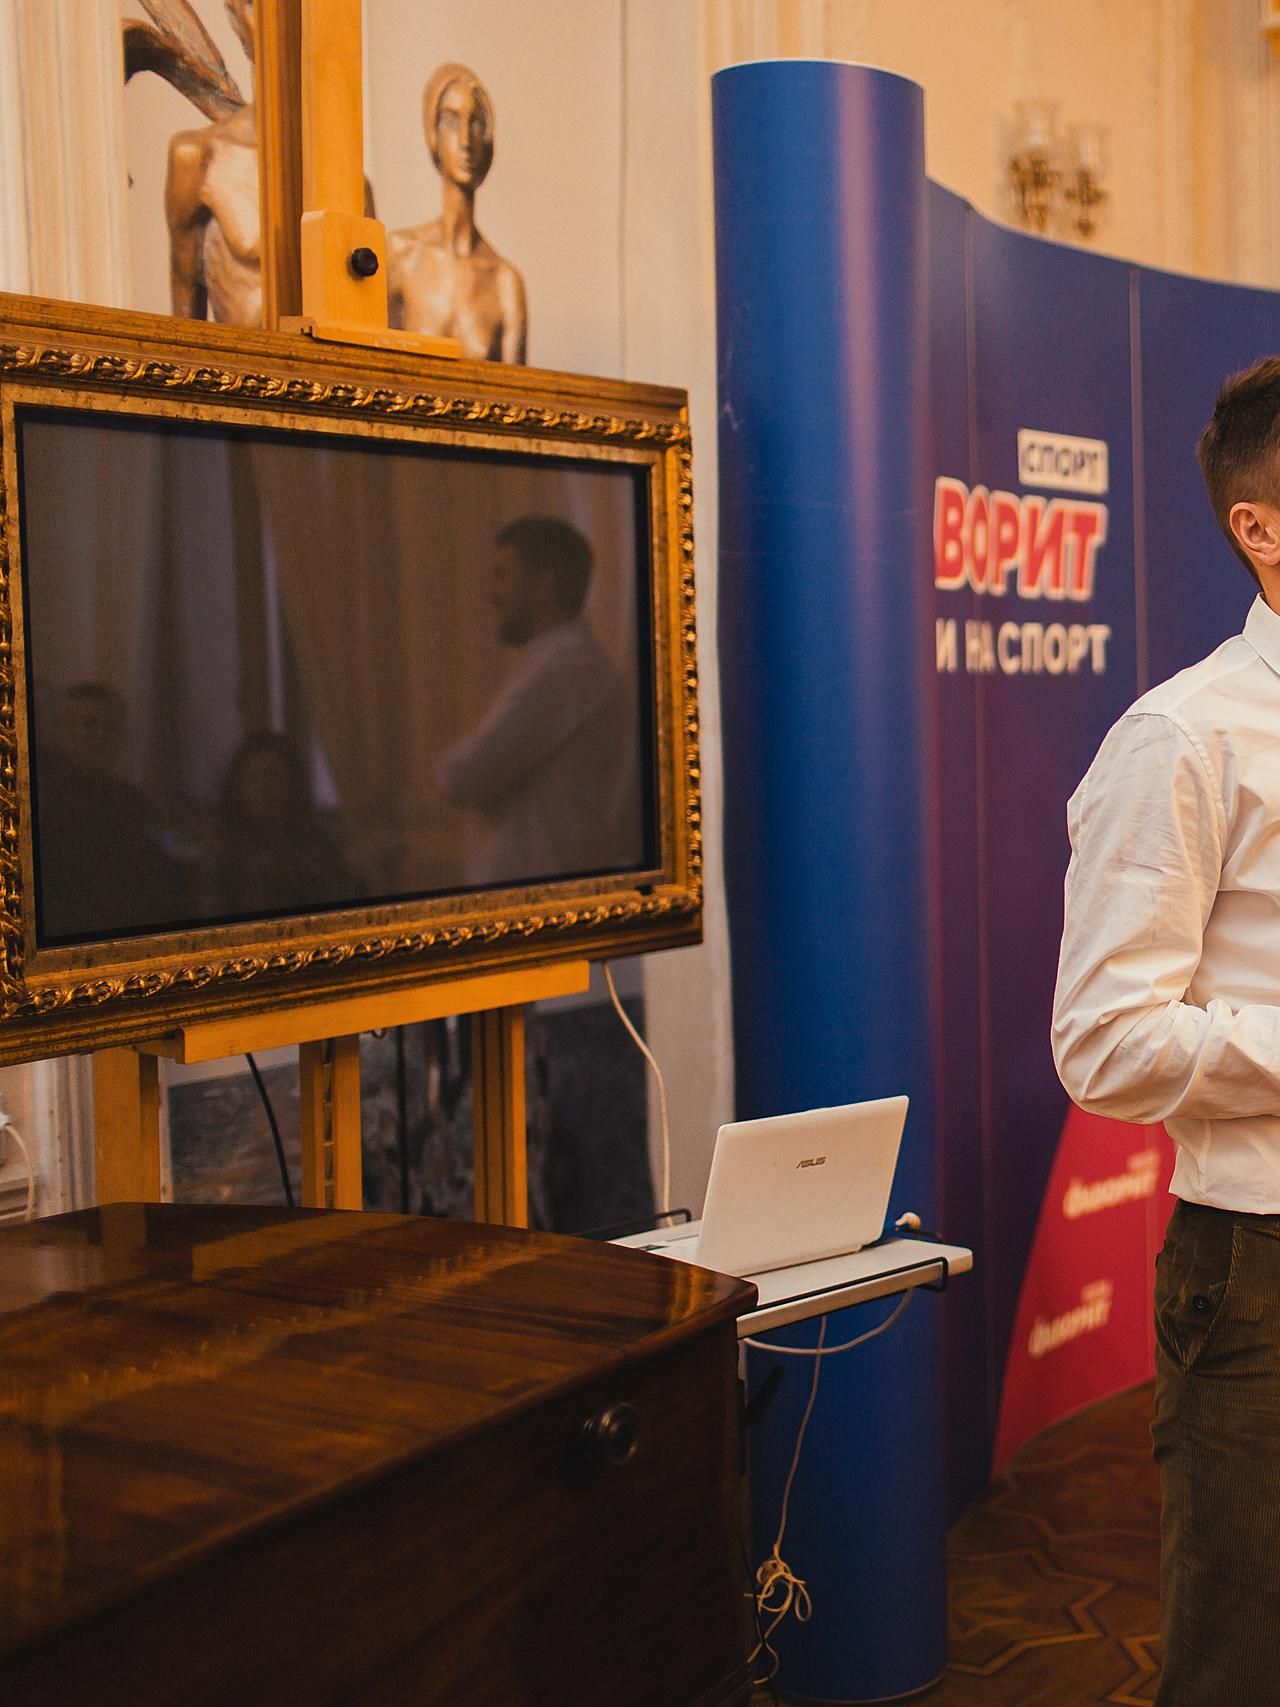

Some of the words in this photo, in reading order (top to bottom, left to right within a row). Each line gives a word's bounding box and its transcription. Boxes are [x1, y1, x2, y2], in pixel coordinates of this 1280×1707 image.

[1023, 442, 1099, 478] СПОРТ
[997, 621, 1111, 674] СПОРТ
[796, 1156, 826, 1169] ASUS
